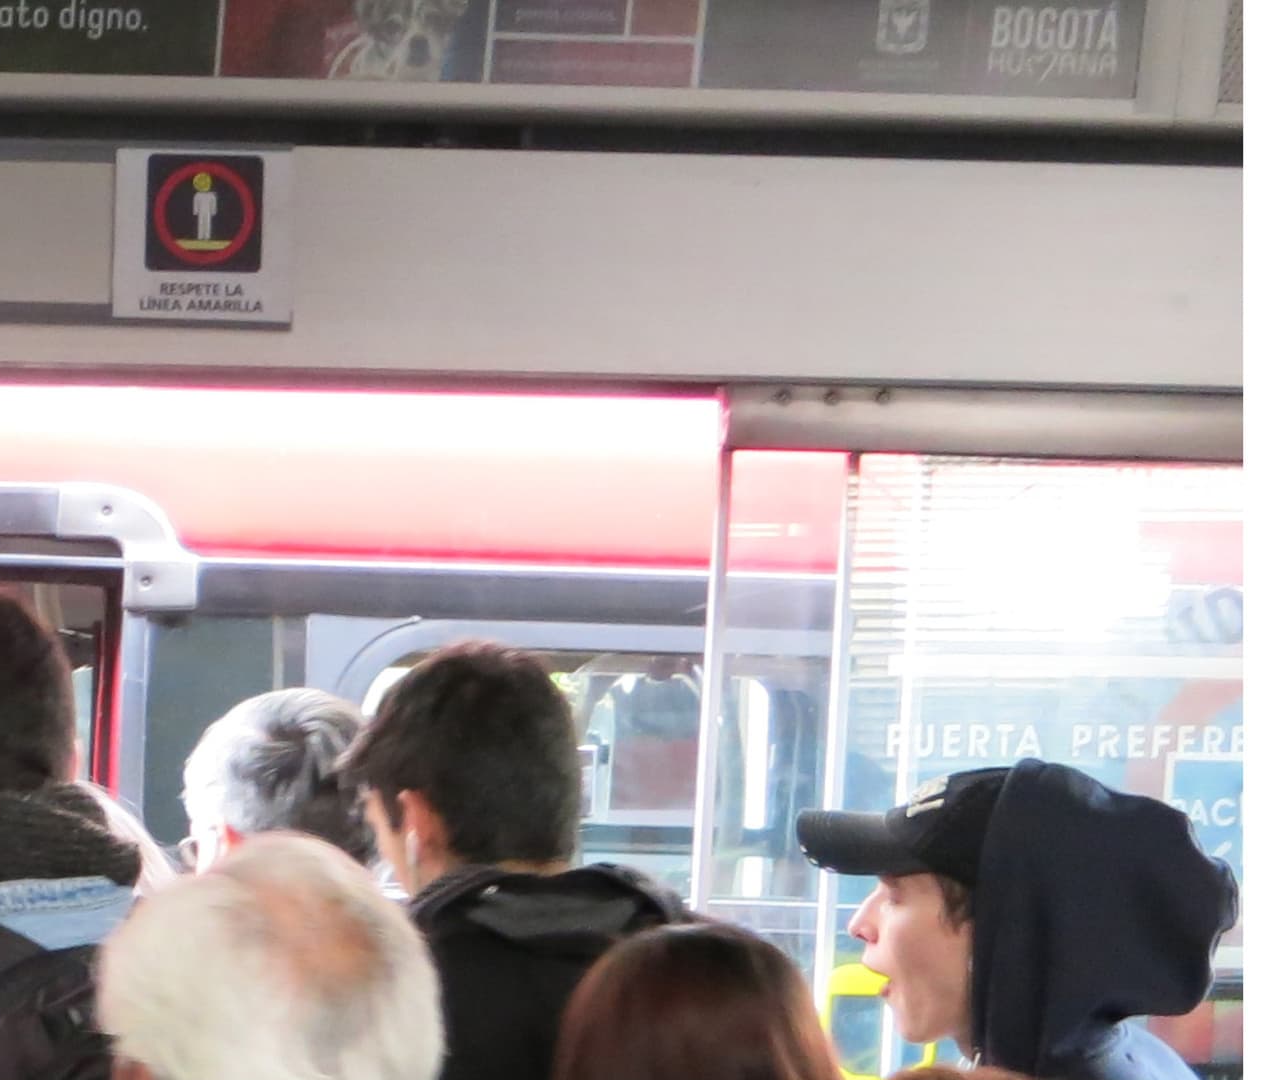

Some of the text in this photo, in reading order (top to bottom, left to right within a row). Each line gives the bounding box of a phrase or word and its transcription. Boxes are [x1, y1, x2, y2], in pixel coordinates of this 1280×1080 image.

[58, 0, 149, 39] digno.
[991, 1, 1118, 48] BOGOTÁ
[160, 282, 243, 296] RESPETE LA
[186, 299, 264, 313] AMARILLA
[886, 721, 1042, 758] PUERTA
